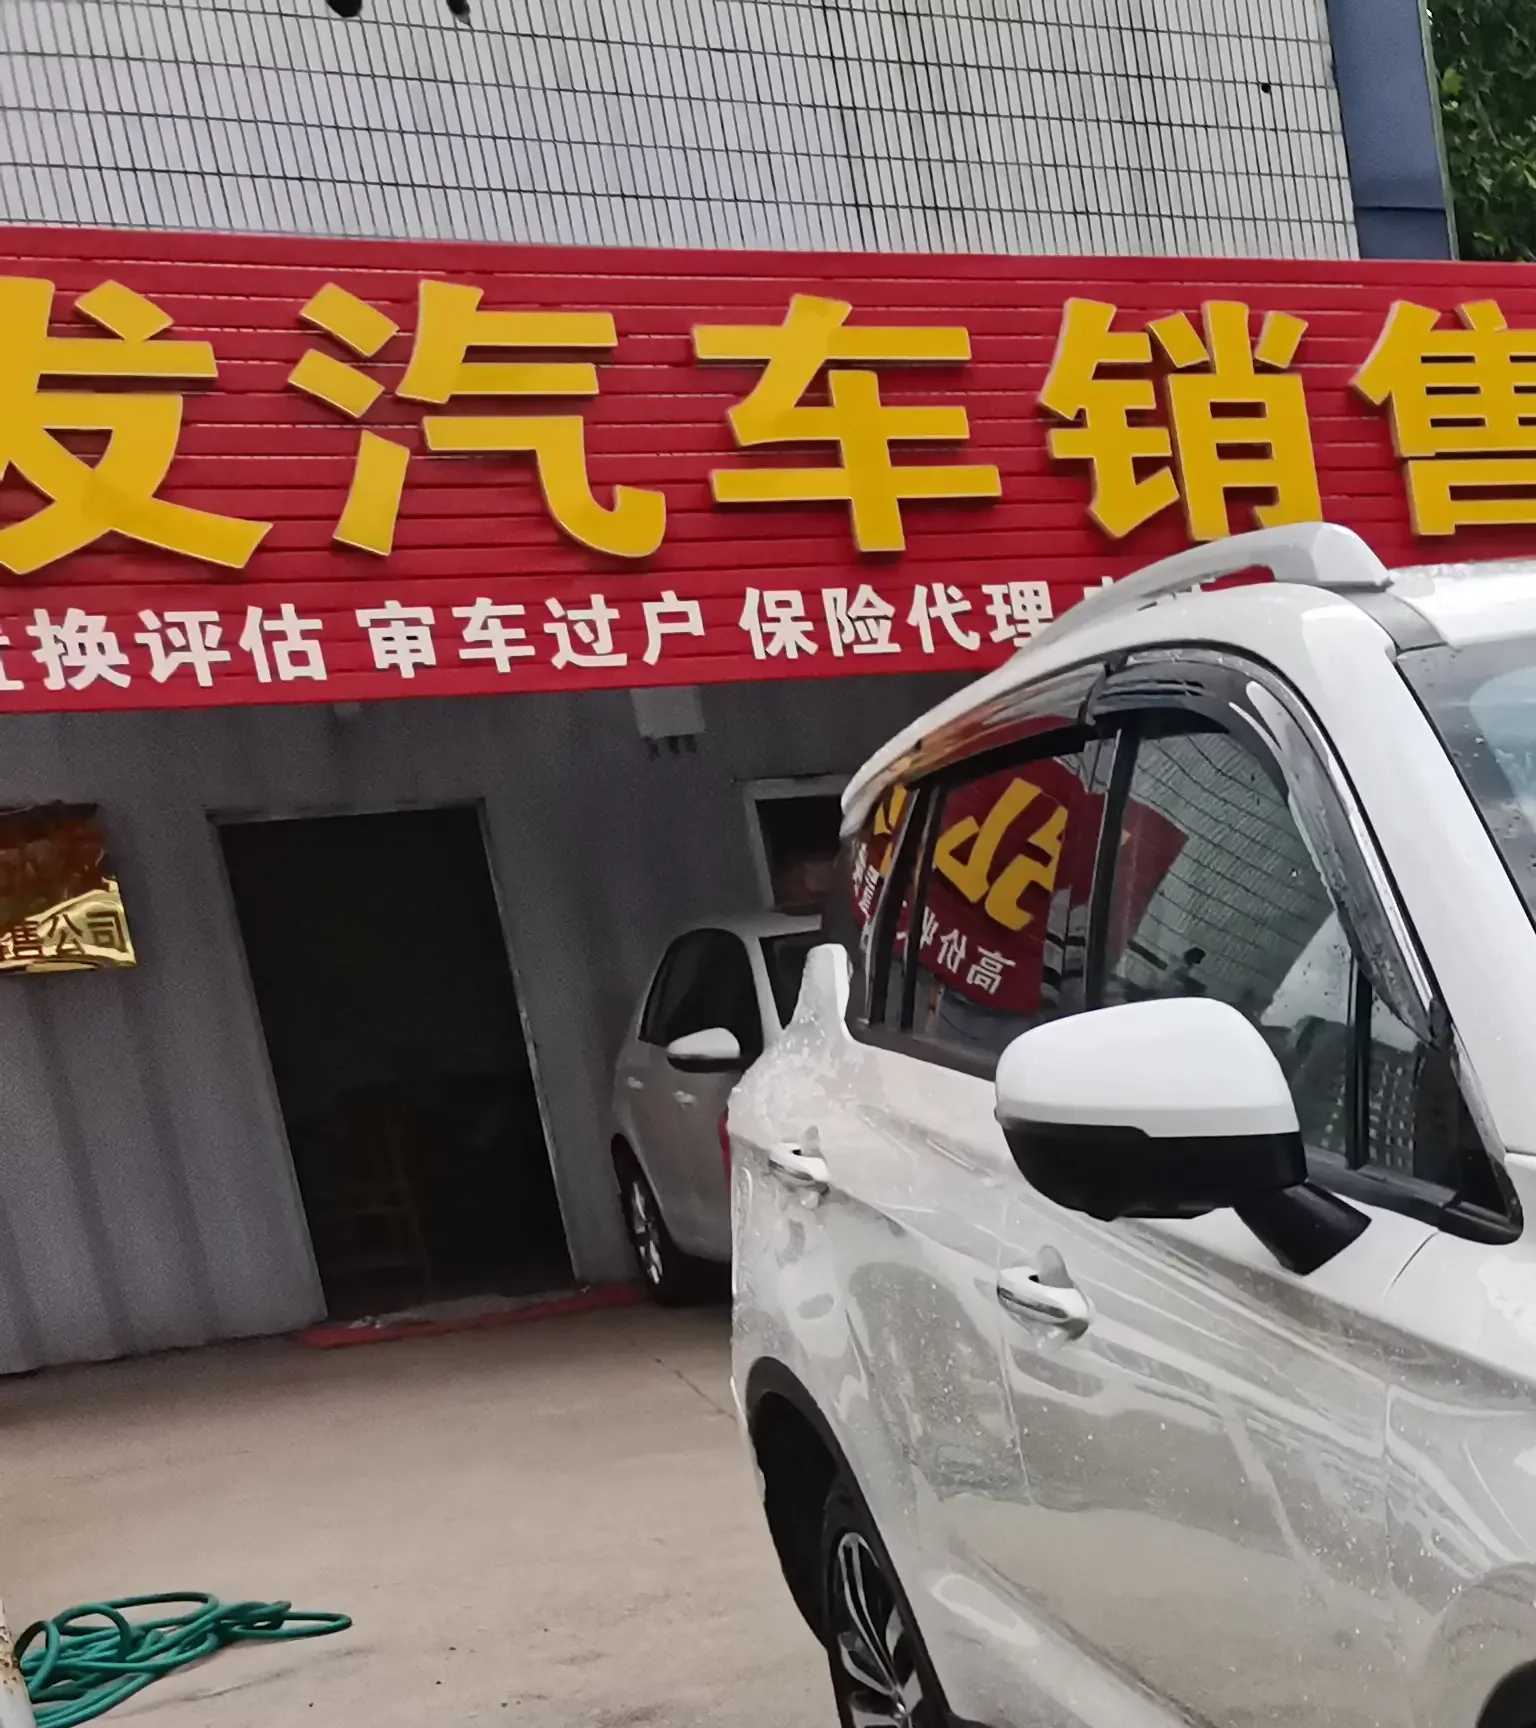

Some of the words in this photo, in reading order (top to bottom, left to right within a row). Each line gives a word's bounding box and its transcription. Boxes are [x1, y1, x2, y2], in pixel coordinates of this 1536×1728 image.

[0, 603, 327, 691] 换评估
[355, 591, 705, 678] 审车过户
[739, 580, 1054, 659] 保险代理
[0, 912, 131, 957] 售公司
